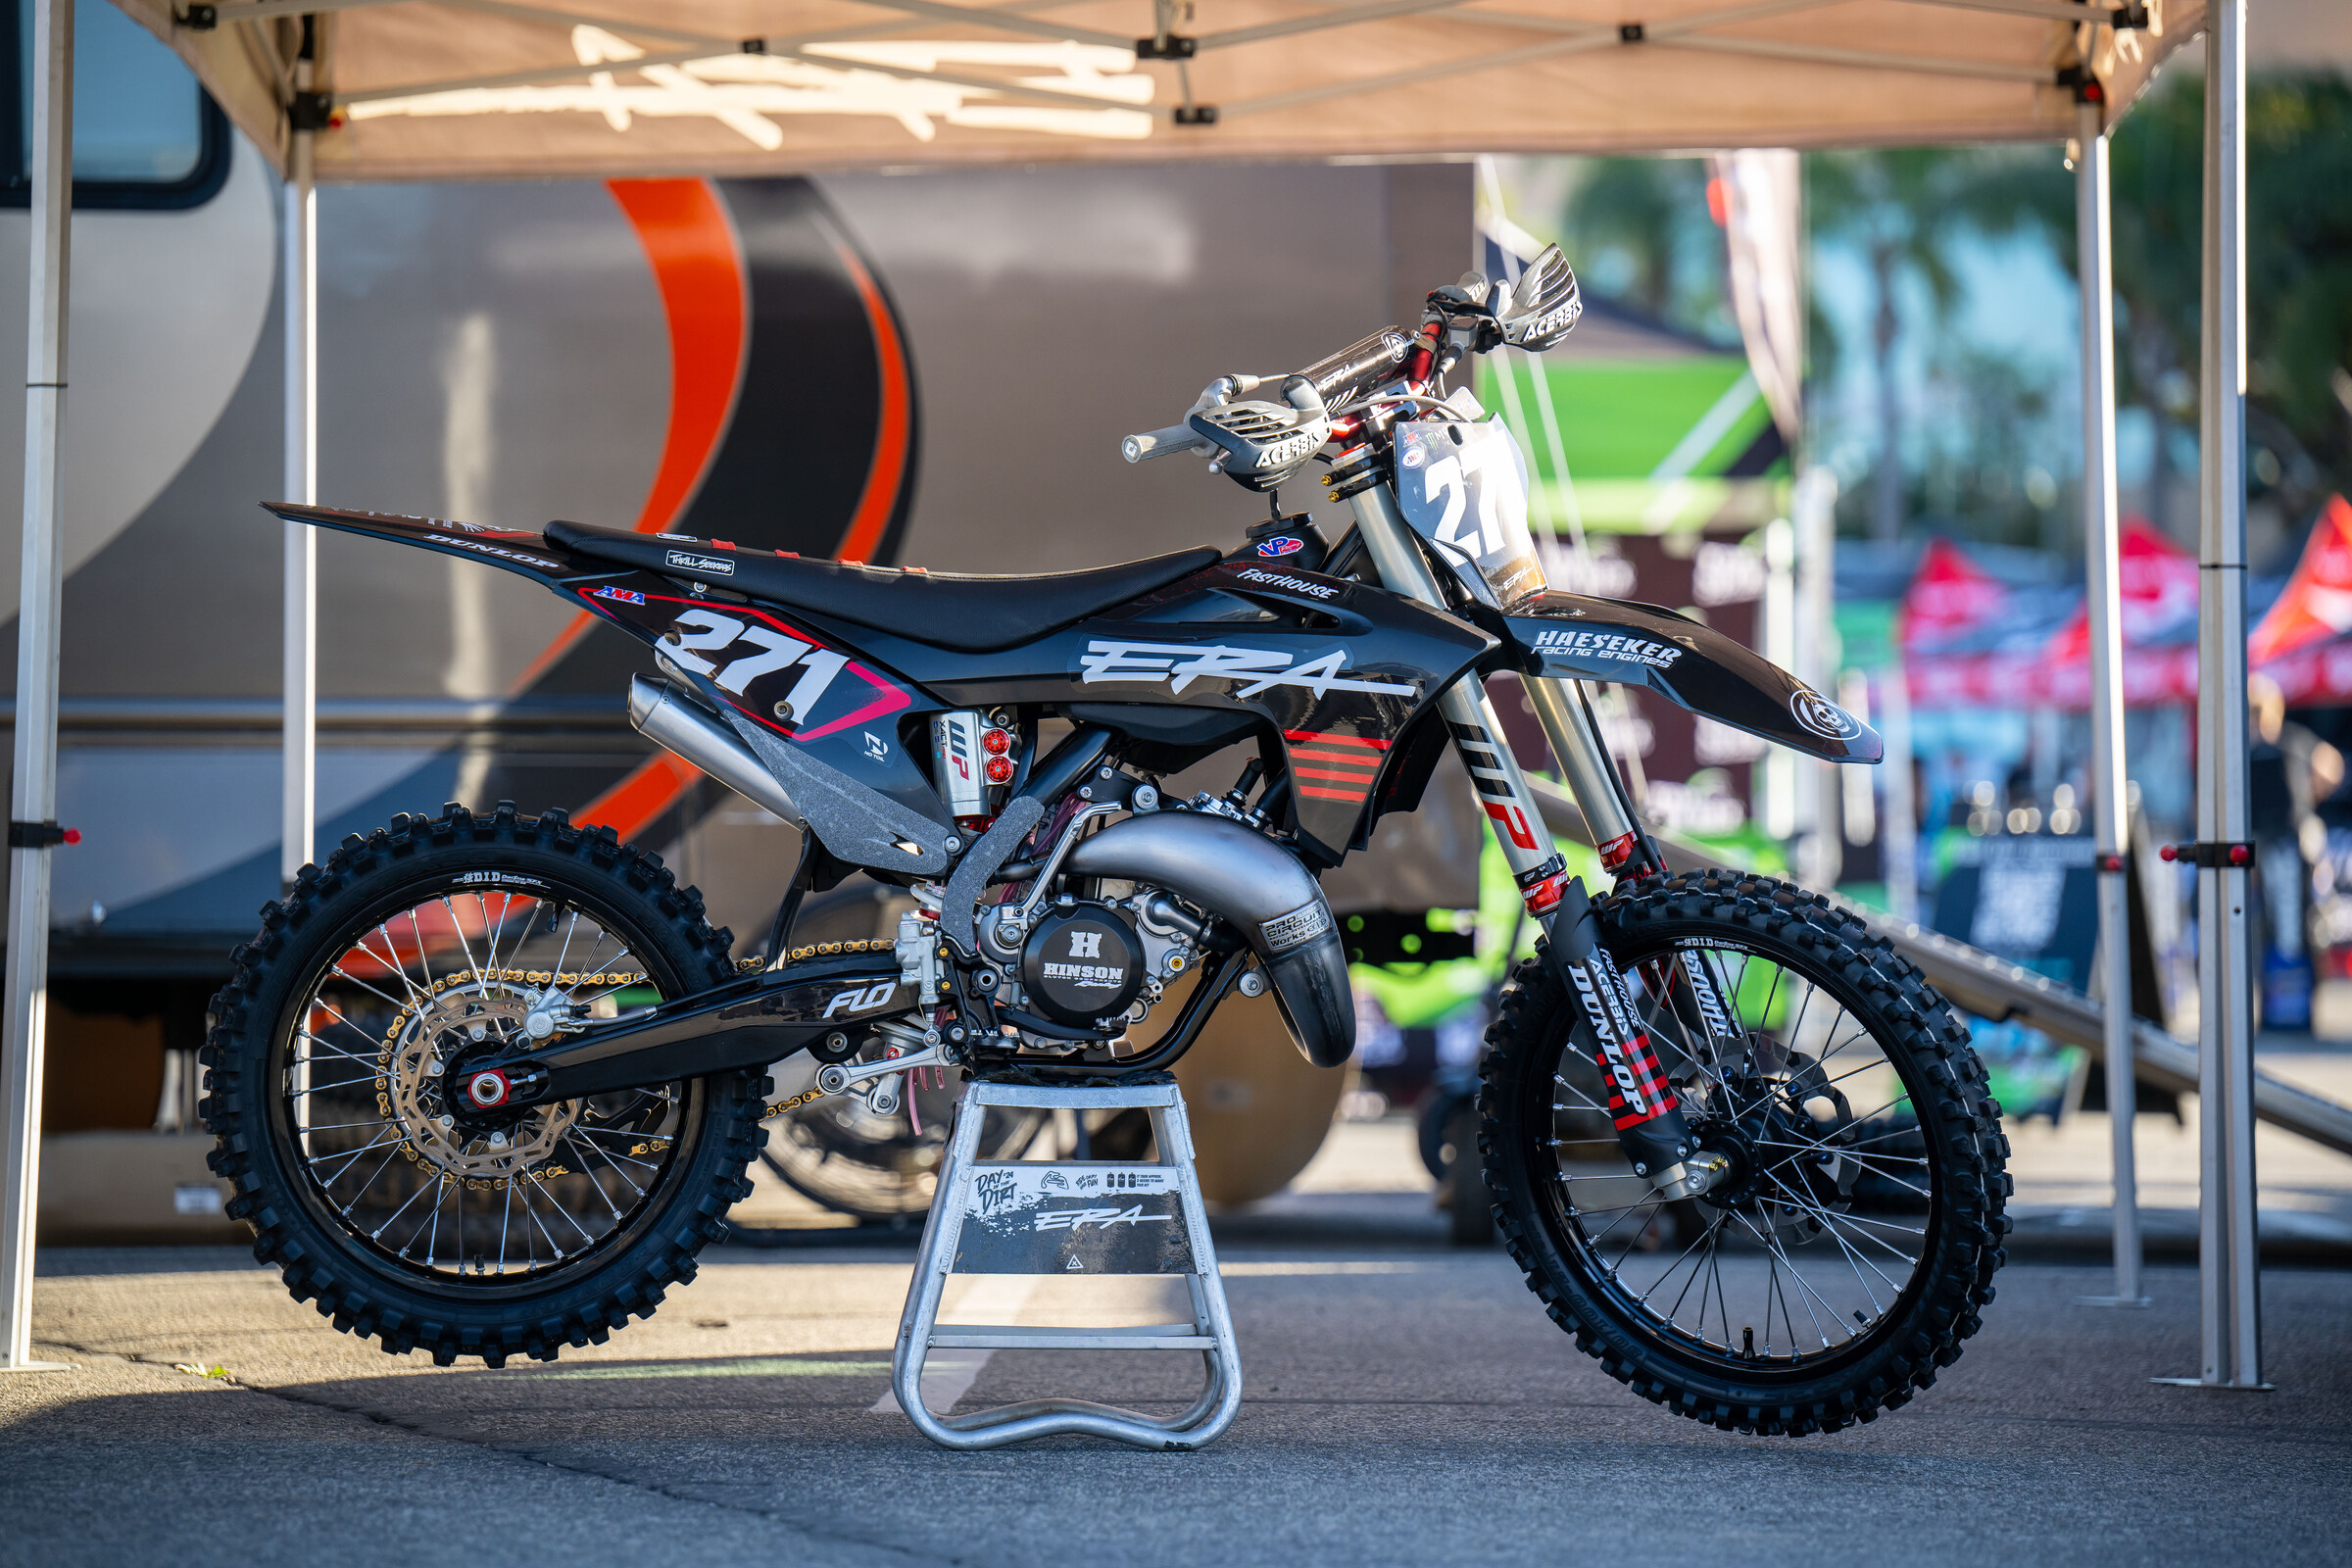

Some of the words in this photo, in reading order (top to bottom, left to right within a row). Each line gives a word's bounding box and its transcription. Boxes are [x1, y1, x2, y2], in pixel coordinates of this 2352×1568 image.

[1522, 301, 1583, 342] ACERBIS
[423, 534, 559, 568] DUNLOP
[1256, 536, 1289, 556] VP
[669, 554, 698, 566] THRILL
[699, 559, 732, 572] SEEKERS
[593, 585, 645, 605] AMA
[1237, 568, 1339, 599] FASTHOUSE
[1535, 630, 1683, 662] HAESEKER
[655, 609, 850, 725] 271
[1080, 640, 1416, 700] ERA
[939, 720, 948, 747] XACT
[949, 719, 970, 780] WP
[1446, 719, 1539, 850] WP
[1600, 839, 1624, 855] WP
[1522, 884, 1544, 899] WP
[1265, 916, 1297, 931] PRO
[1267, 908, 1322, 938] CIRCUIT
[1069, 931, 1102, 958] H
[1270, 931, 1305, 947] Works
[1044, 962, 1123, 980] HINSON
[822, 982, 897, 1018] FLO
[1590, 958, 1628, 1035] ACERBIS
[1599, 948, 1642, 1029] FASTHOUSE
[1568, 965, 1647, 1114] DUNLOP
[974, 1169, 1004, 1194] DAY
[978, 1183, 1017, 1214] DIRT
[1034, 1203, 1172, 1232] ERA
